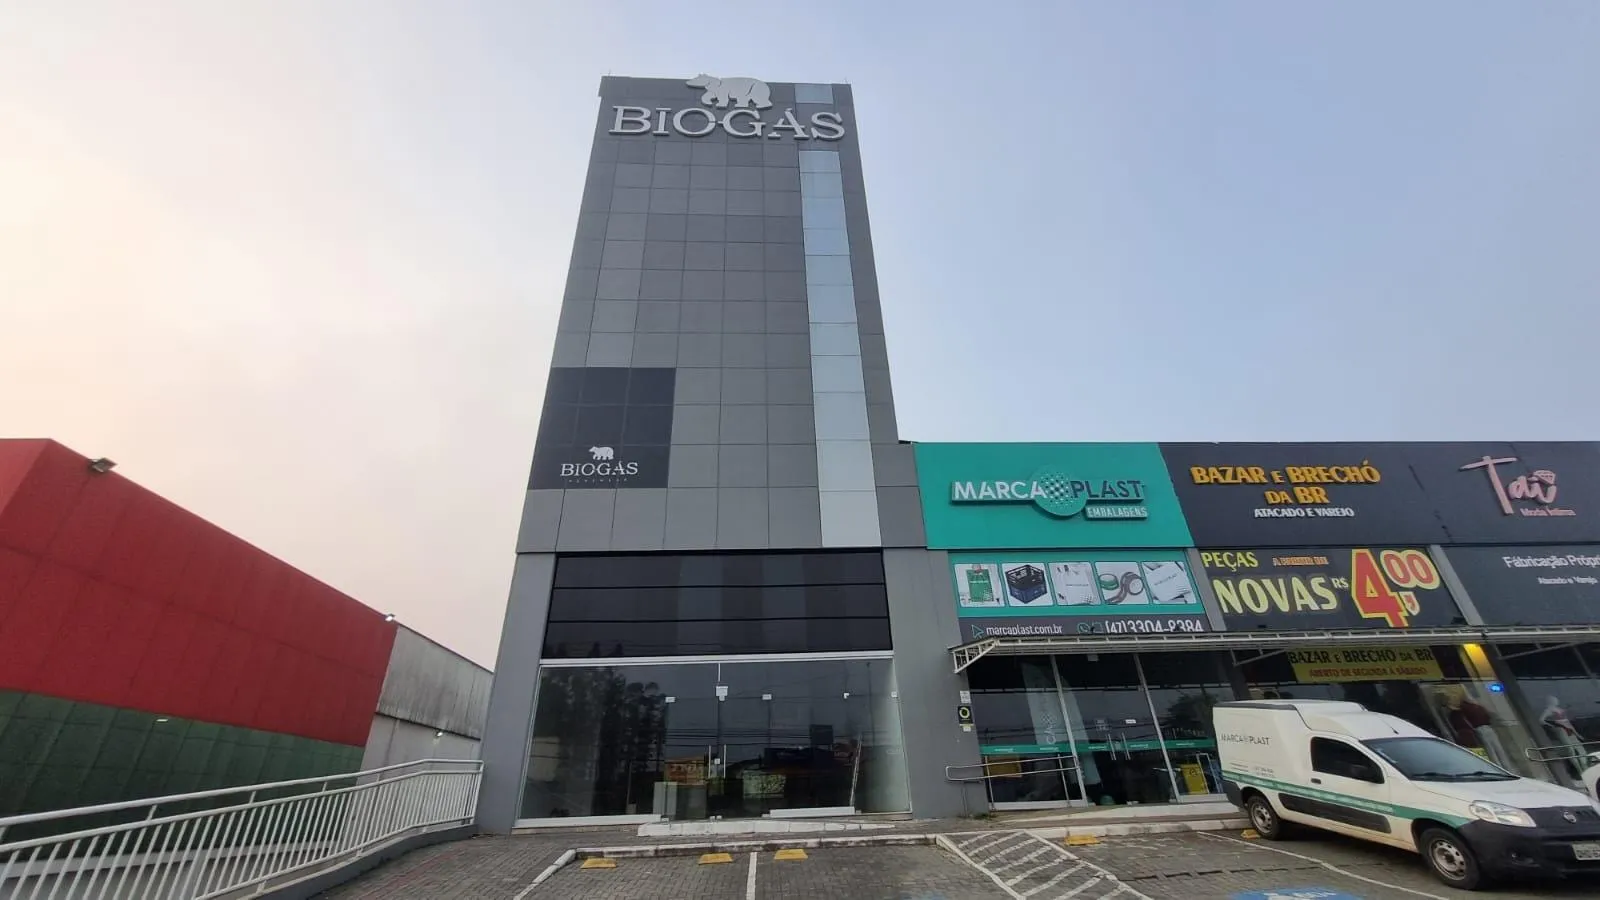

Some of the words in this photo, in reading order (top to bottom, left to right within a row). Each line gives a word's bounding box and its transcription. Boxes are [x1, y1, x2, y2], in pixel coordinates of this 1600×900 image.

[1190, 465, 1268, 484] BAZAR
[1272, 470, 1285, 483] E
[1285, 459, 1381, 484] BRECHÓ
[954, 481, 1048, 500] MARCA
[1070, 480, 1143, 499] PLAST
[1264, 490, 1293, 505] DA
[1293, 486, 1331, 505] BR
[1086, 507, 1148, 518] EMBALAGENS
[1254, 507, 1305, 518] ATACADO
[1307, 507, 1315, 518] E
[1317, 507, 1355, 518] VAREJO
[1201, 552, 1259, 572] PEÇAS
[1212, 577, 1338, 614] NOVAS
[986, 624, 1063, 636] marcaplast.com.br
[1290, 651, 1331, 664] BAZAR
[1249, 736, 1270, 745] PLAST
